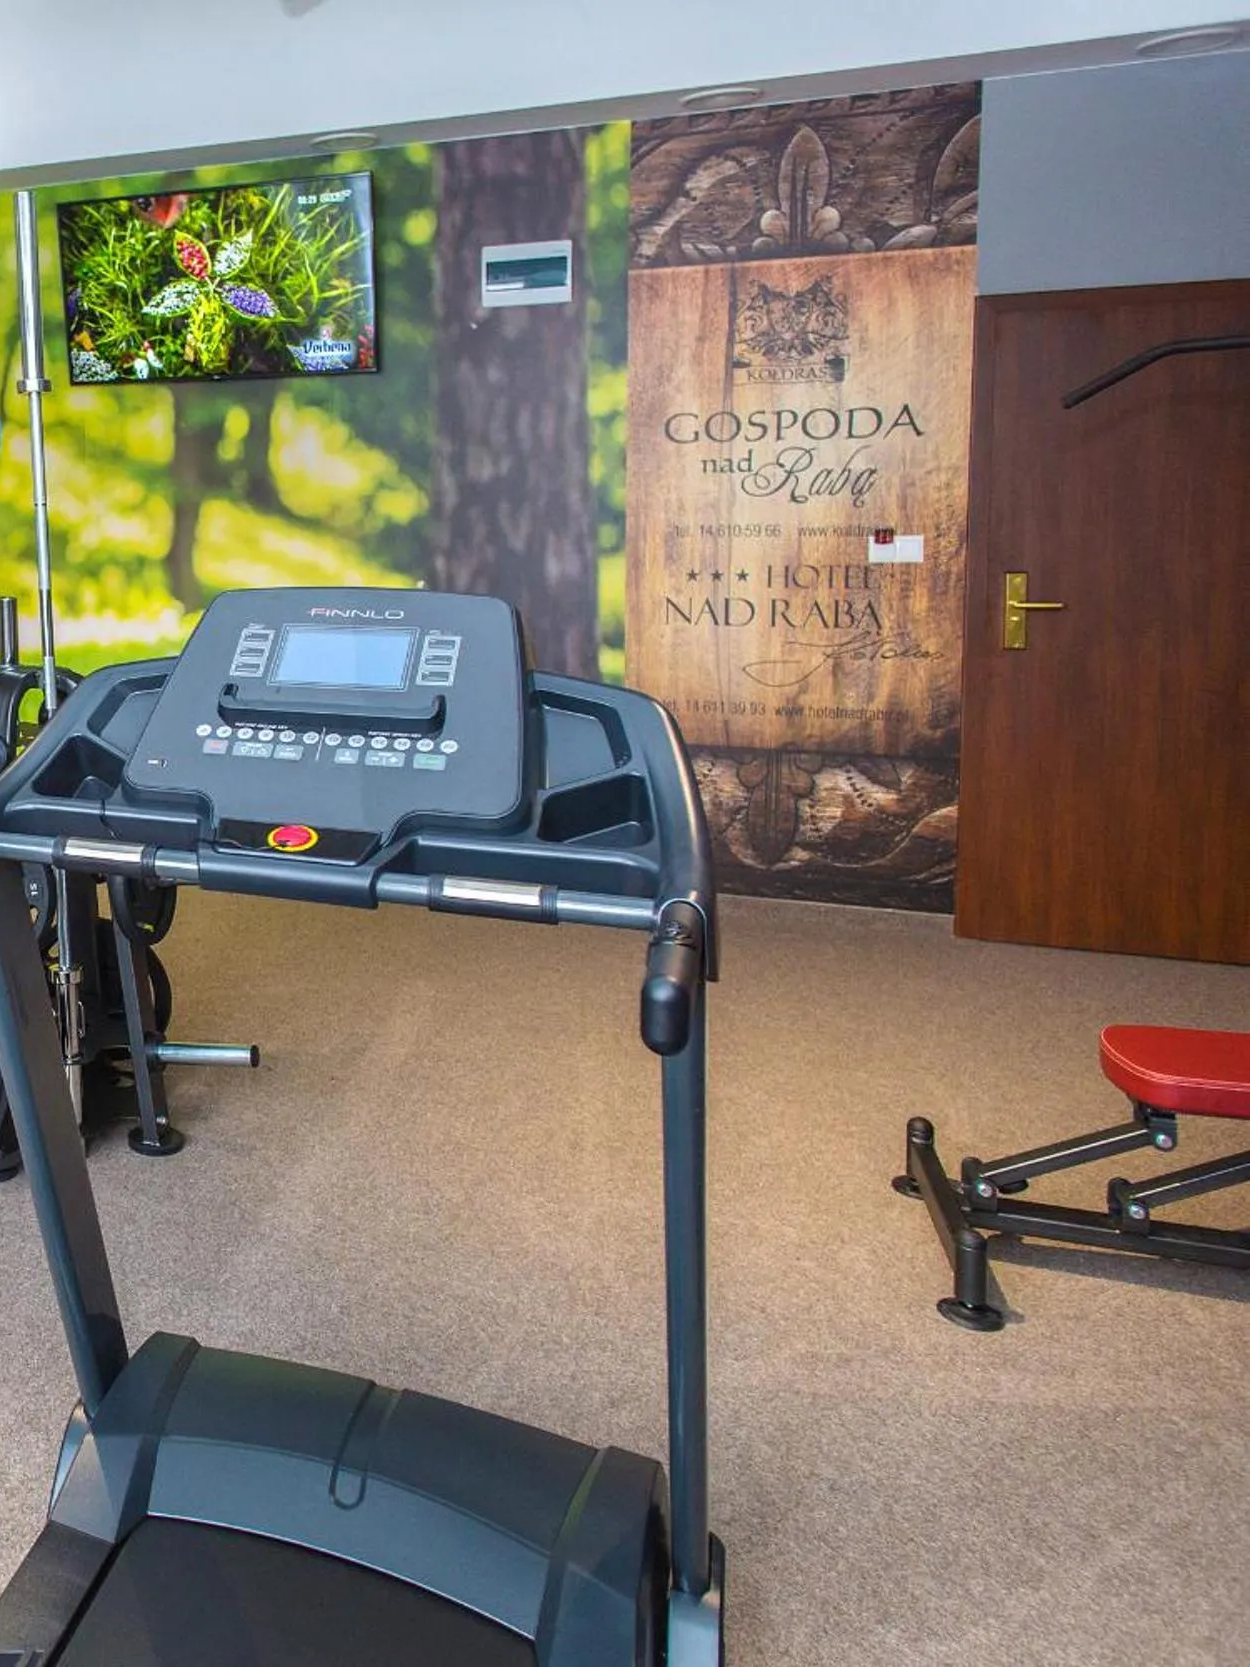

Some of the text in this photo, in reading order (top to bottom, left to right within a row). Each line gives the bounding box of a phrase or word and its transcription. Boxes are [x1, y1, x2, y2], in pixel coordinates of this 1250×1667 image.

[664, 403, 925, 444] GOSPODA
[700, 448, 755, 474] nad
[766, 564, 882, 590] HOTEL
[309, 608, 404, 620] FINNLO
[664, 597, 756, 628] NAD
